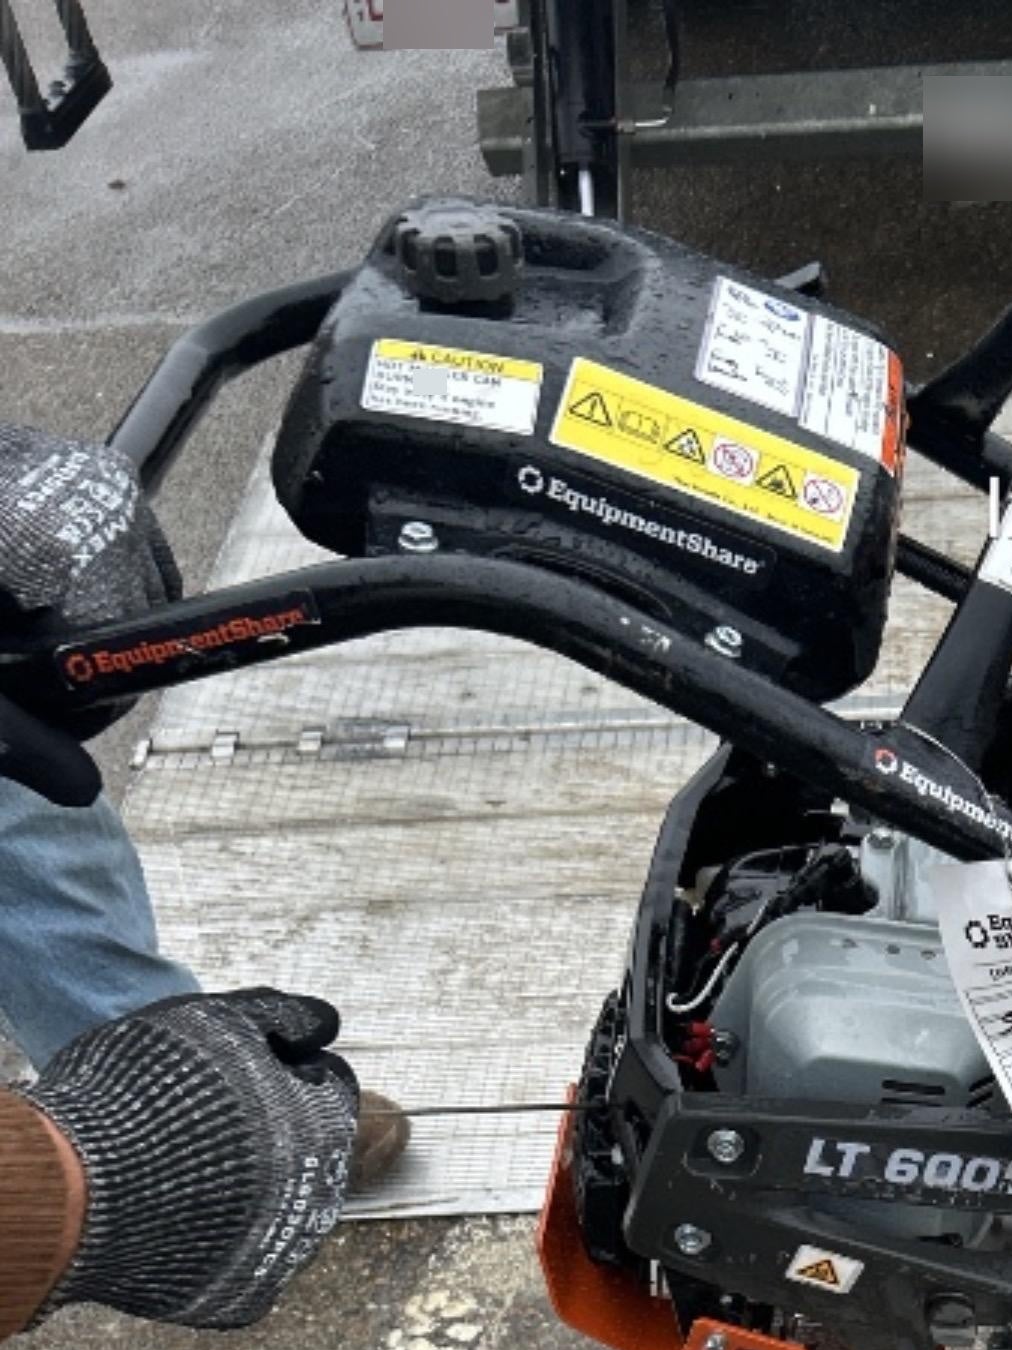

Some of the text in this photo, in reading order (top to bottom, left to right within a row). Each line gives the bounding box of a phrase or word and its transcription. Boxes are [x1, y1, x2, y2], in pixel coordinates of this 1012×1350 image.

[431, 351, 505, 373] CAUTION
[545, 477, 760, 575] EquipmentShare
[93, 606, 306, 673] EquipmentShare
[803, 1137, 871, 1178] LT
